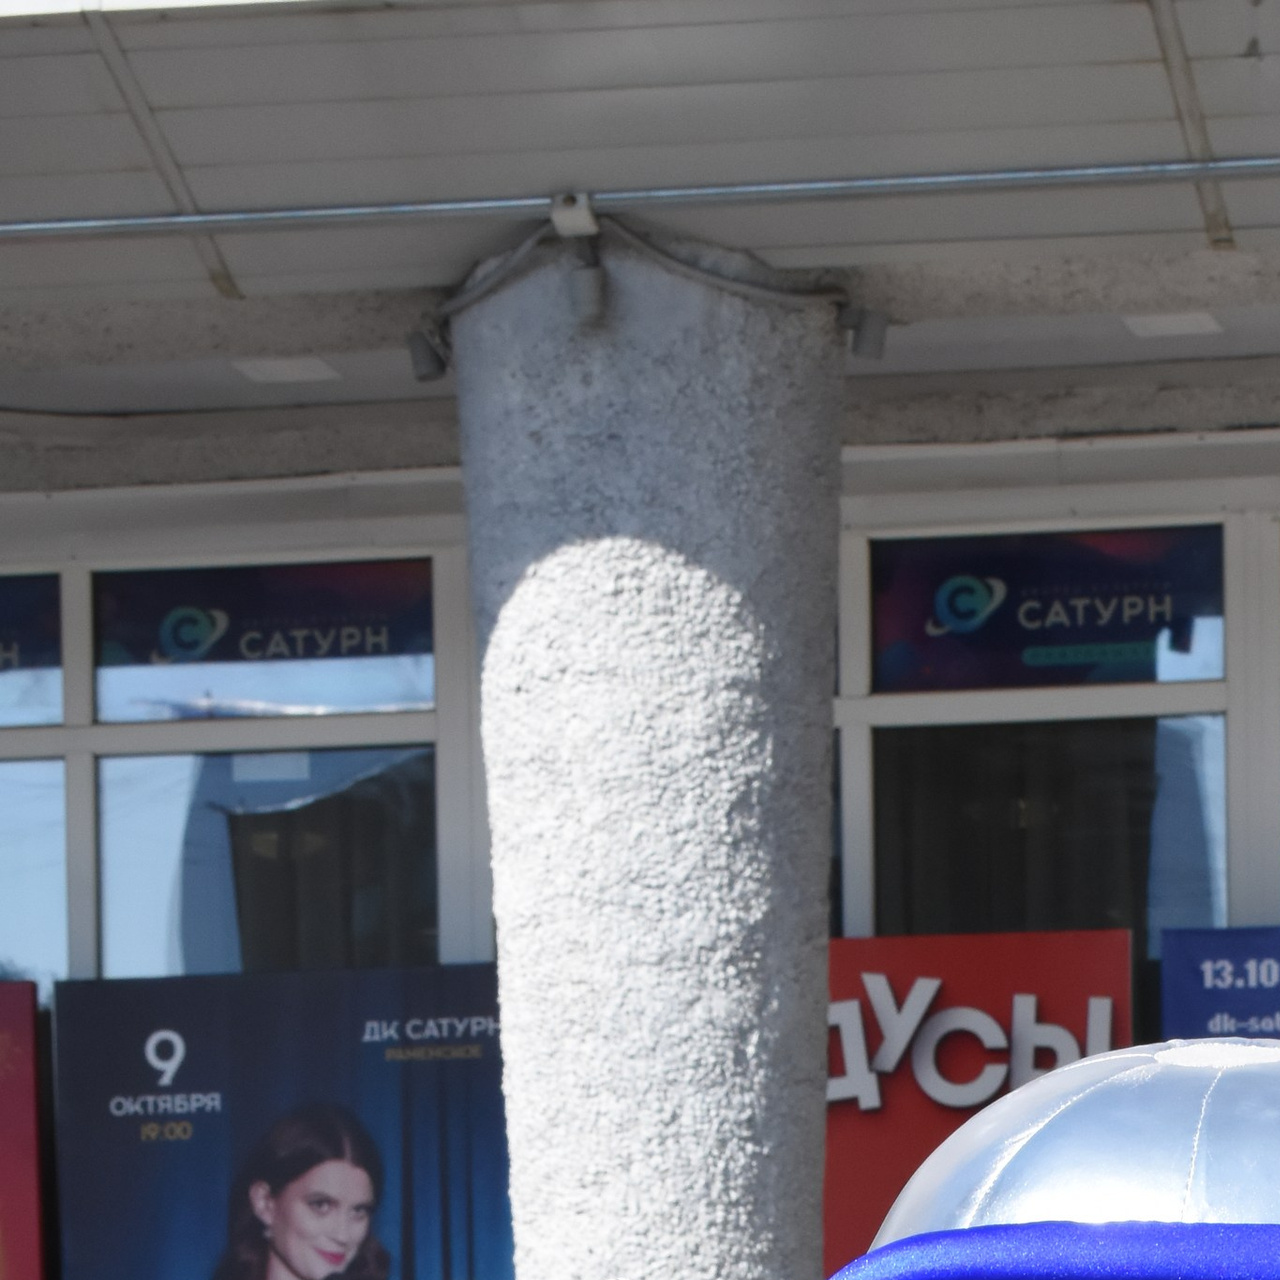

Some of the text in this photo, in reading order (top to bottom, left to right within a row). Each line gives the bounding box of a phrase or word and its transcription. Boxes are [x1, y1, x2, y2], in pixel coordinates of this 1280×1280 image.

[1017, 595, 1172, 630] САТУРН
[239, 626, 389, 660] САТУРН
[1201, 957, 1280, 989] 13.10
[362, 1019, 399, 1042] ДК
[826, 972, 1112, 1111] ДУСЫ
[144, 1029, 186, 1087] 9
[109, 1091, 222, 1117] ОКТЯБРЯ
